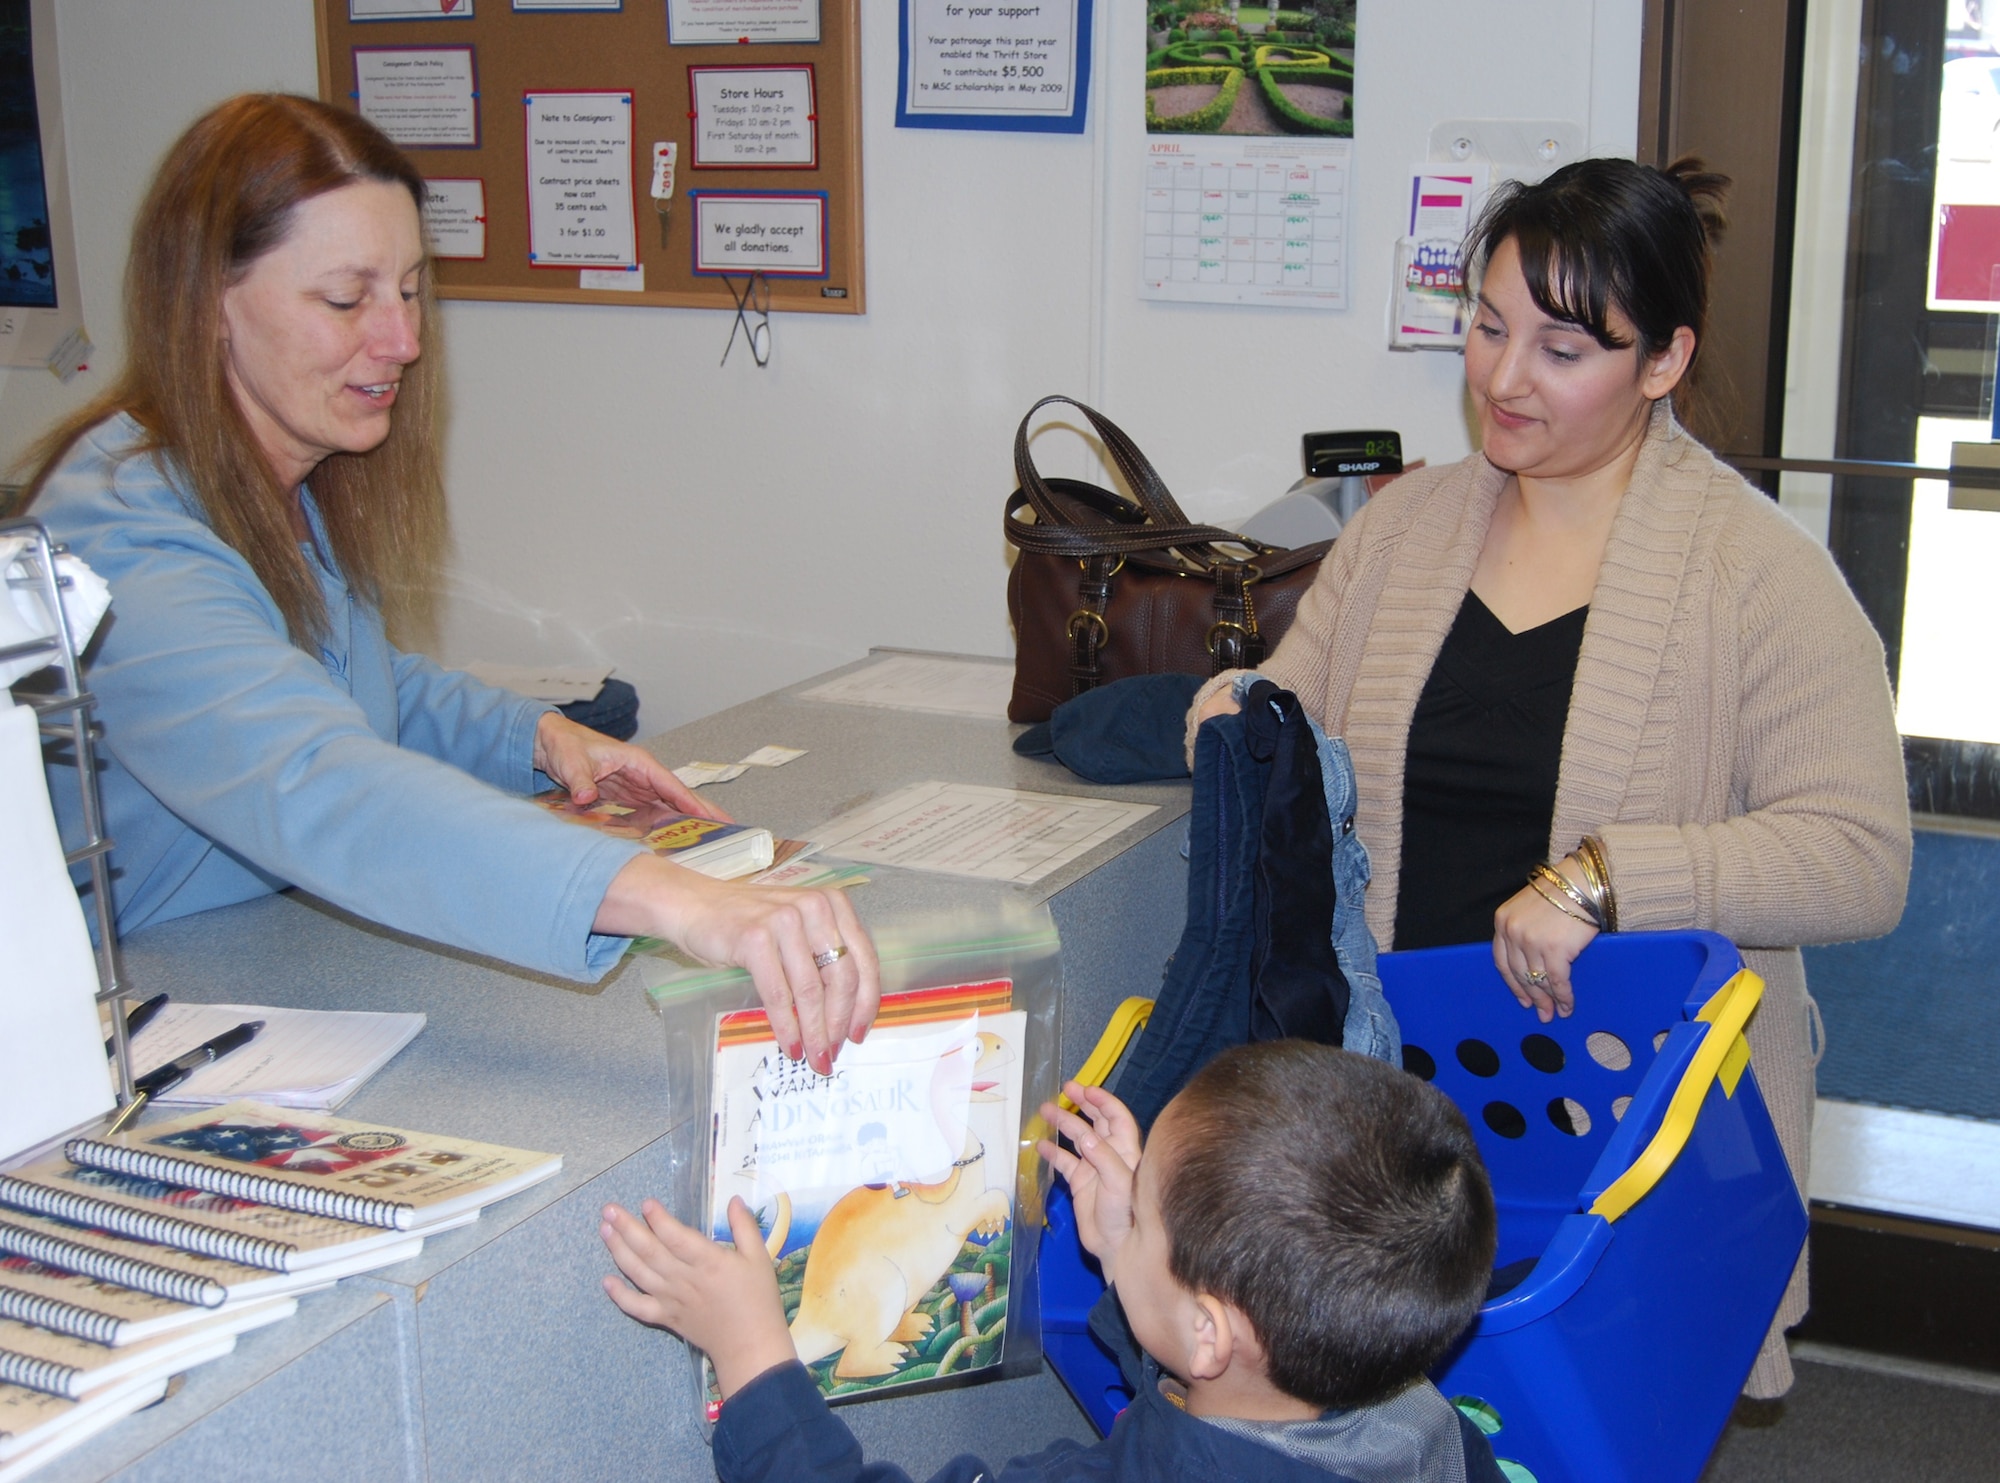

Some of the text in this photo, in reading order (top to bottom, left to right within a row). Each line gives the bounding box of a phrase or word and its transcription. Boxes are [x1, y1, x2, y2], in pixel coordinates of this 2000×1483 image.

[946, 4, 1041, 19] for your support
[928, 36, 1057, 47] Your patronage this past year
[940, 50, 1048, 60] enabled the Thrift Store
[943, 65, 1044, 79] to contribute $5,500
[720, 87, 784, 99] Store Hours
[920, 82, 929, 91] to
[932, 82, 951, 91] MSC
[954, 82, 1004, 94] scholarships
[1008, 83, 1016, 92] in
[1018, 83, 1037, 94] May
[751, 104, 760, 113] 10
[783, 106, 794, 114] pm
[541, 114, 559, 122] Note
[563, 114, 570, 122] to
[748, 118, 757, 126] 10
[780, 119, 791, 127] pm
[707, 131, 725, 140] First
[728, 131, 762, 140] Saturday
[765, 131, 773, 140] of
[734, 145, 743, 153] 10
[1149, 143, 1182, 153] APRIL
[539, 176, 620, 187] Contract price sheets
[555, 202, 607, 211] 35 cents each
[567, 228, 579, 237] for
[715, 223, 804, 238] We gladly accept
[724, 241, 736, 251] all
[1338, 461, 1380, 473] SHARP
